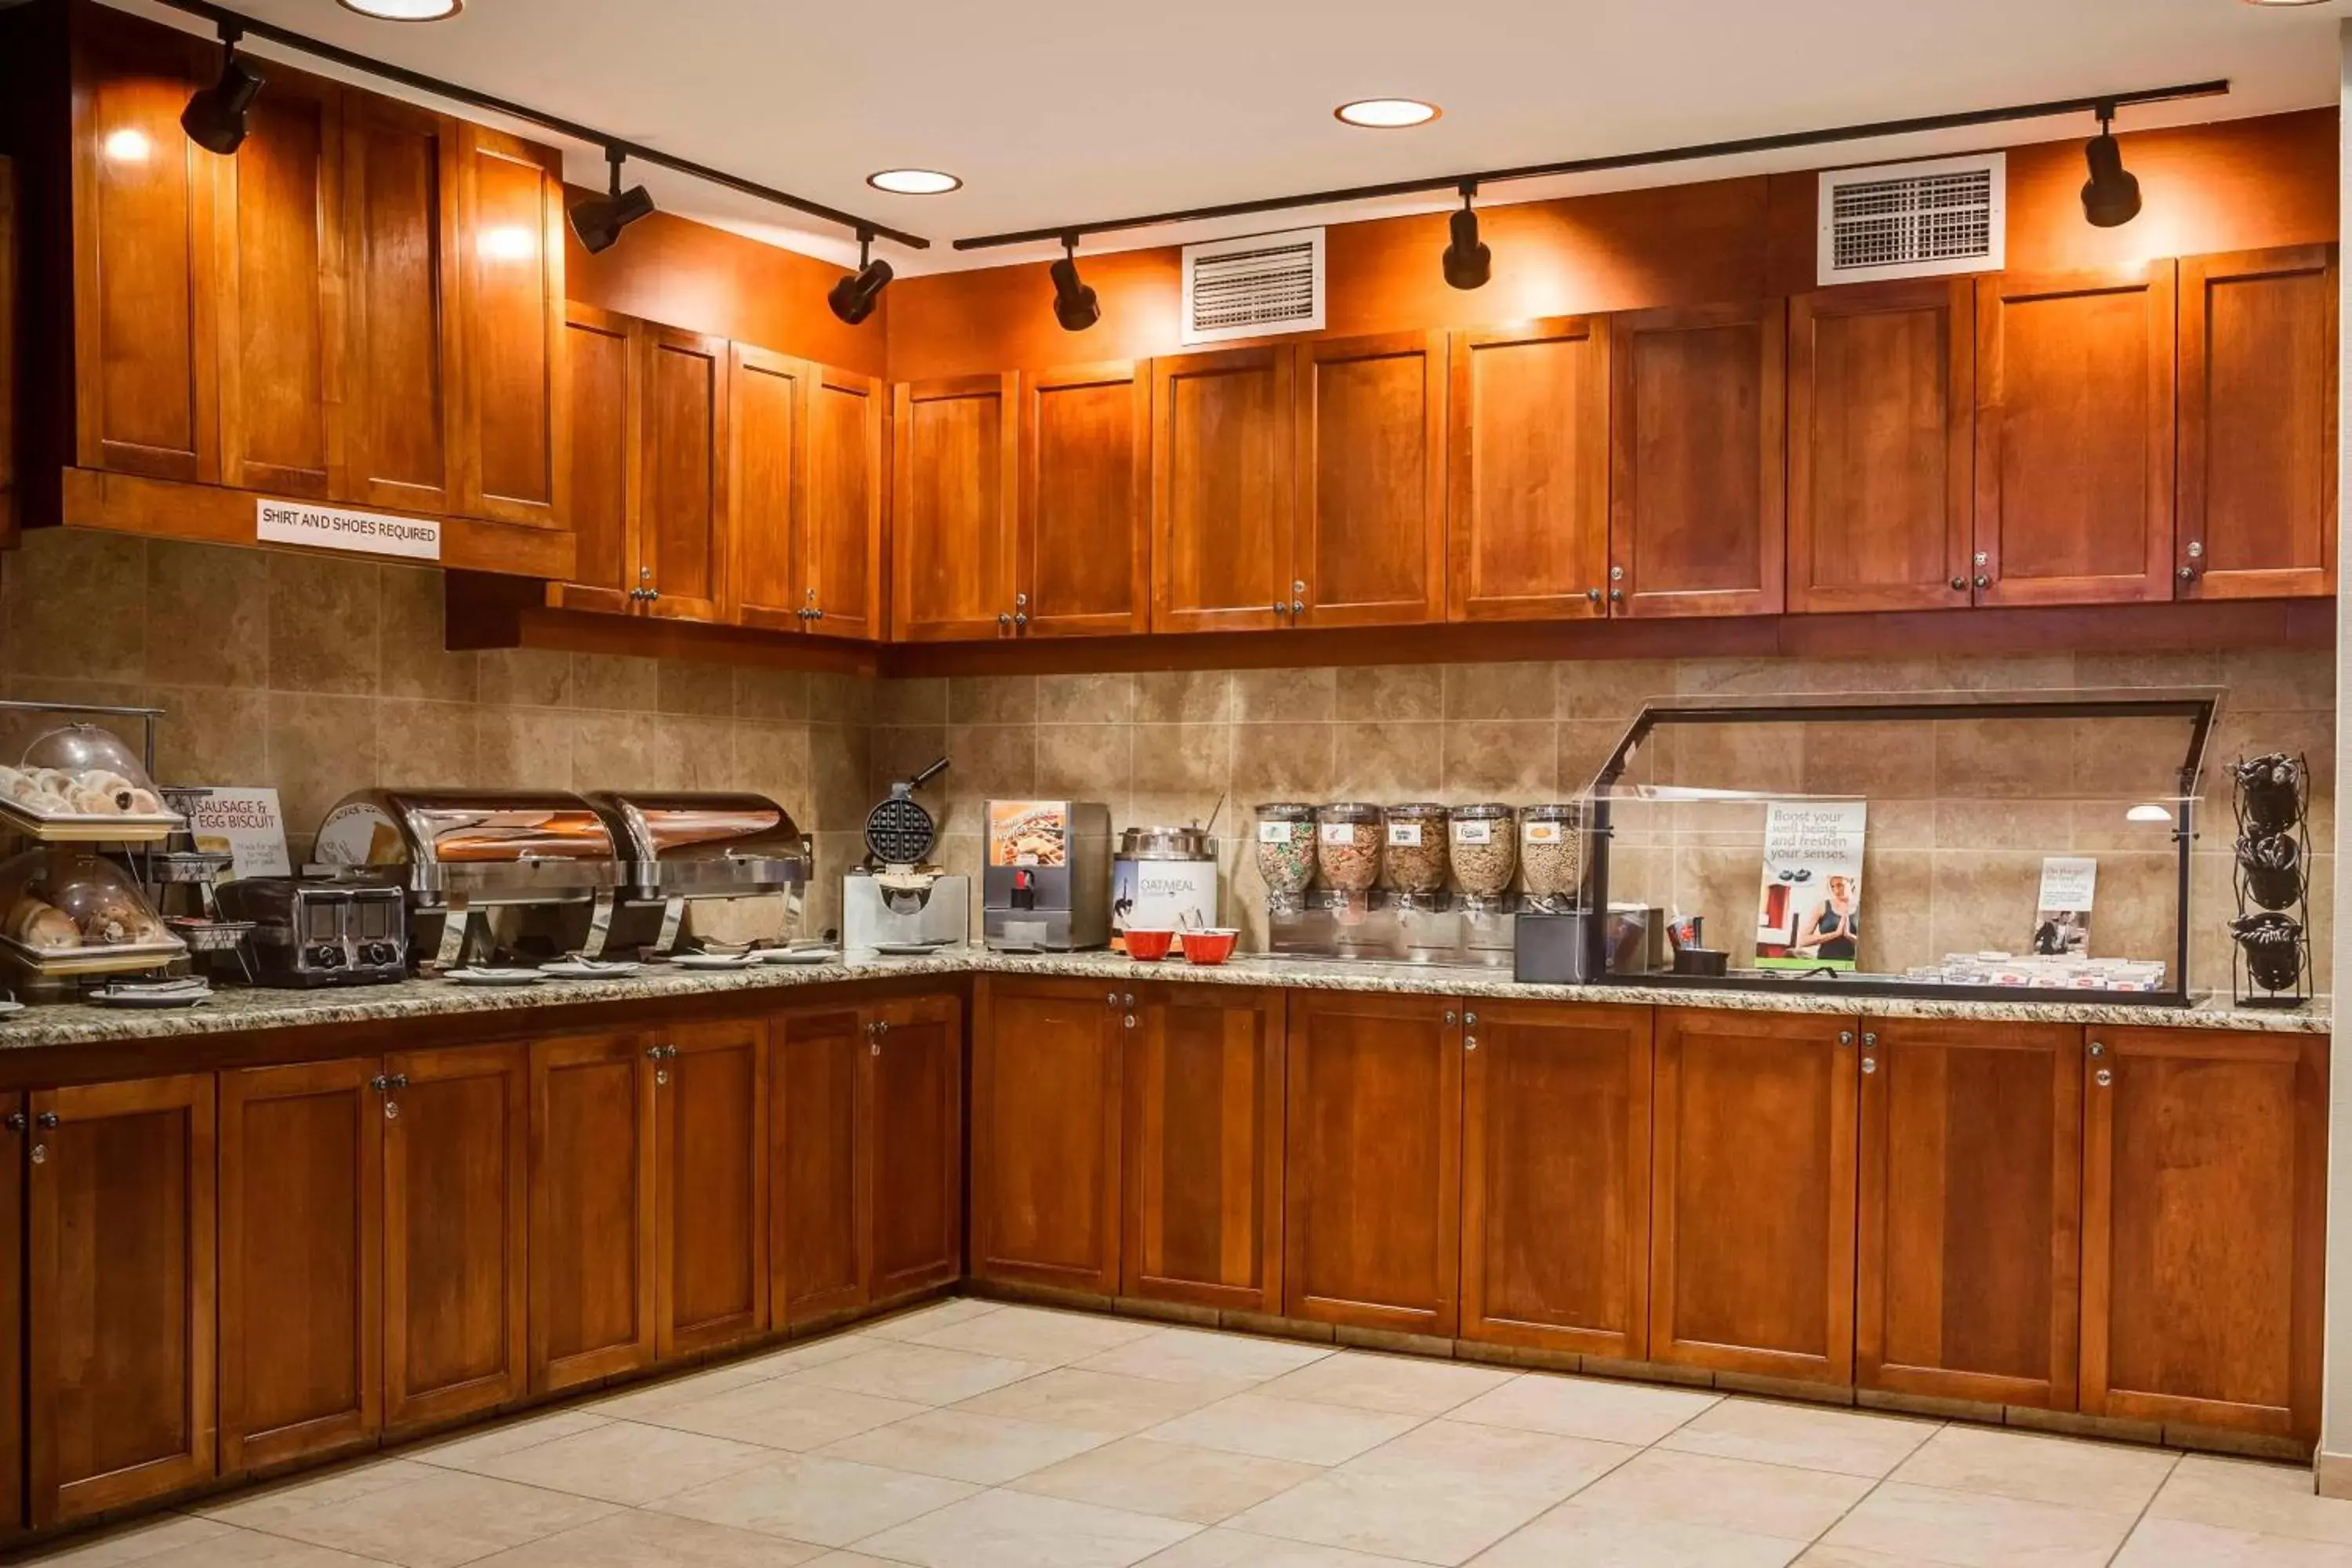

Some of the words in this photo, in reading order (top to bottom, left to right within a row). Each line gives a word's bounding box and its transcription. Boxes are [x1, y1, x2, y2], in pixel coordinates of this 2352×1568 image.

[263, 508, 299, 525] SHIRT
[301, 514, 330, 528] AND
[332, 517, 376, 535] SHOES
[379, 523, 437, 542] REQUIRED
[197, 800, 253, 813] SAUSAGE
[257, 800, 267, 814] &
[198, 815, 226, 828] EGG
[227, 815, 275, 829] BISCUIT
[1774, 809, 1809, 822] Boost
[1814, 812, 1843, 826] your
[1771, 833, 1796, 846] and
[1799, 833, 1847, 846] freshen
[1771, 849, 1800, 861] your
[1141, 879, 1196, 891] OATMEAL
